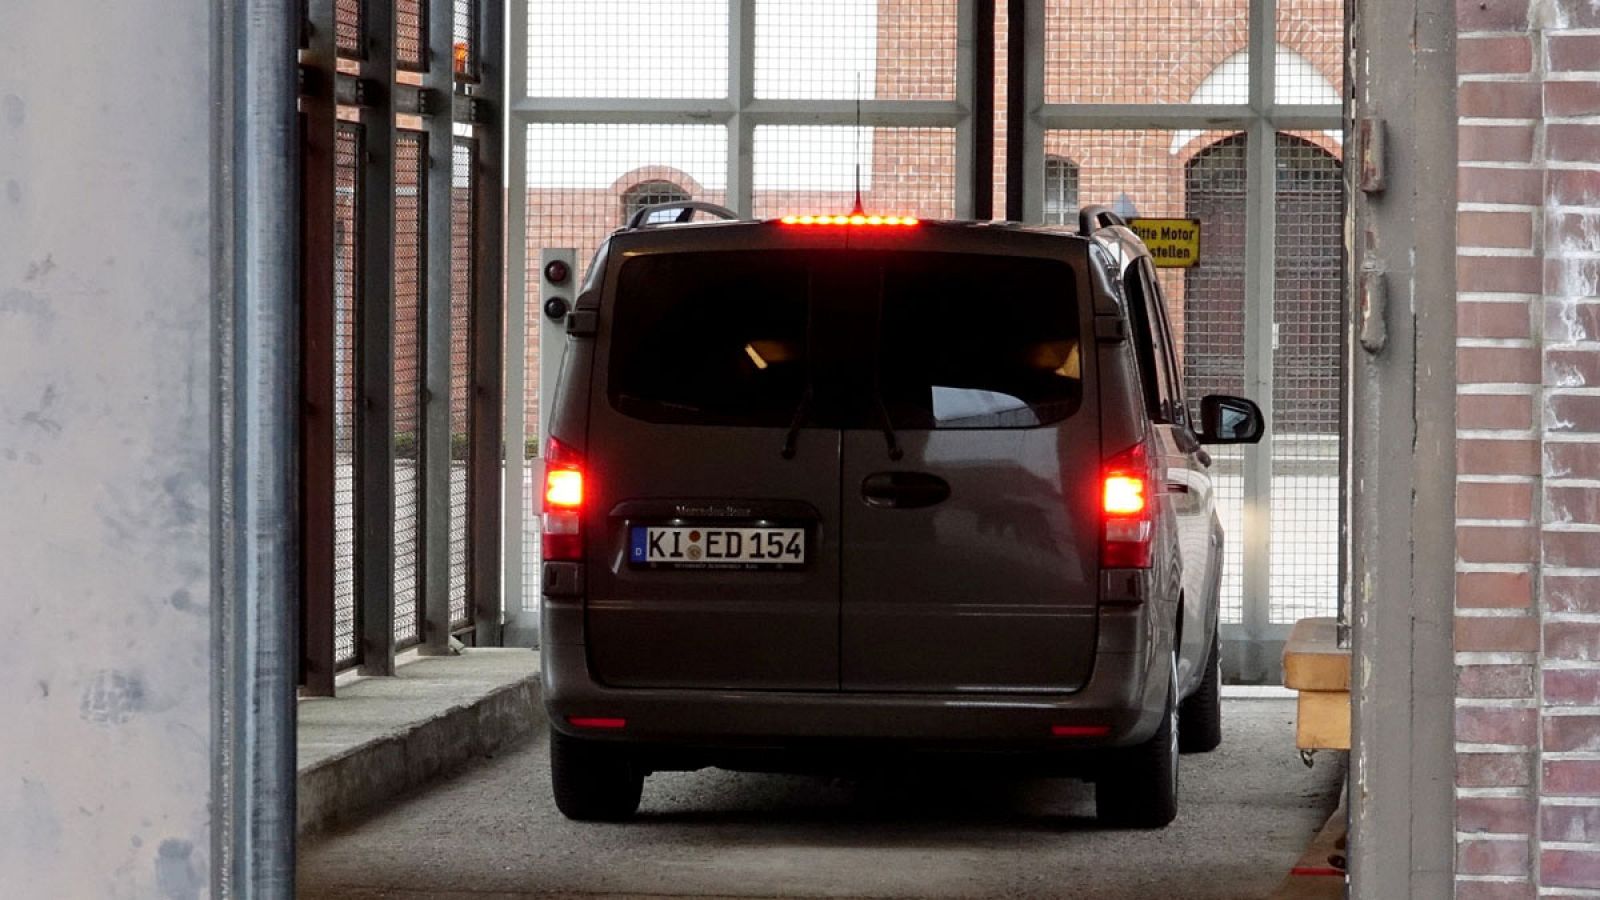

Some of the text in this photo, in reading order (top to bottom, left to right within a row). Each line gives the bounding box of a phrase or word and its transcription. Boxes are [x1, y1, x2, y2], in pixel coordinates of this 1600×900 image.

[1161, 226, 1195, 240] Motor
[1148, 245, 1190, 258] stellen
[635, 531, 803, 559] D KI ED 154
